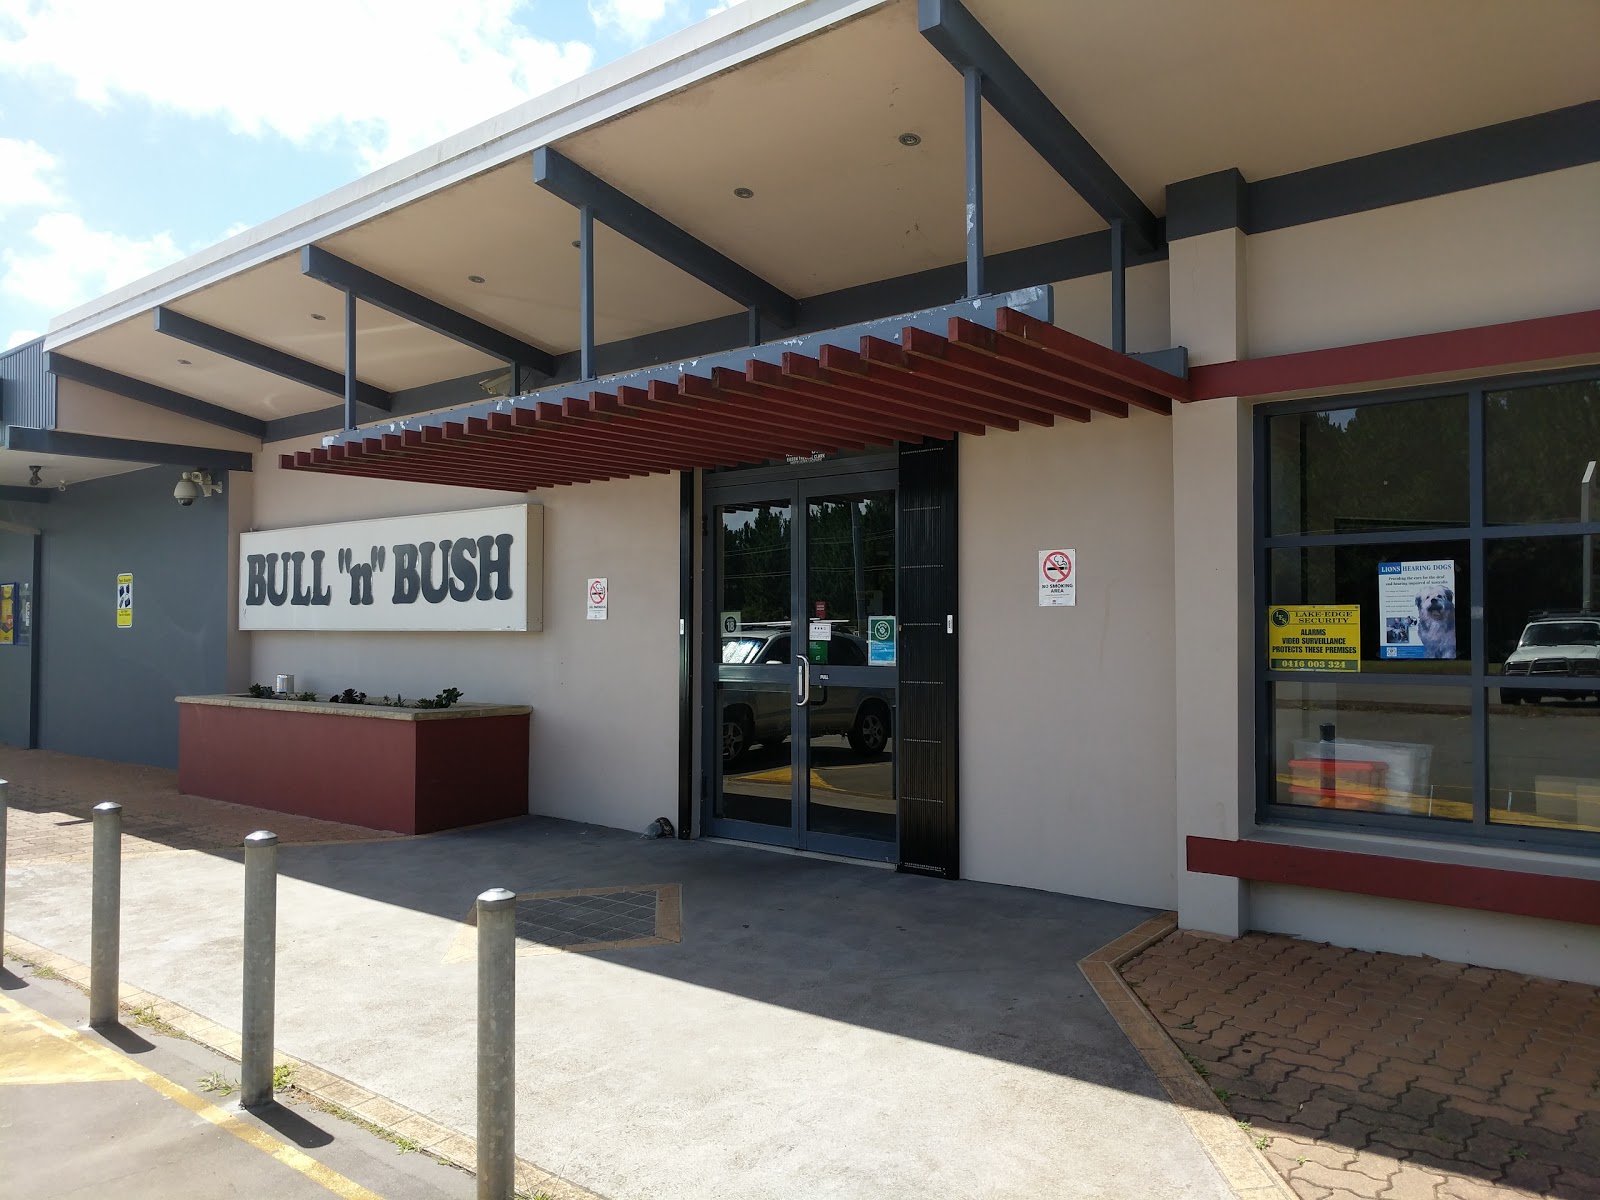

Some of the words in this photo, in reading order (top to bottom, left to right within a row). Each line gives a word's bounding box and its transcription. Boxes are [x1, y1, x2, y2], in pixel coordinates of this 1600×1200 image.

[246, 549, 331, 607] BULL
[338, 545, 386, 606] "n"
[392, 533, 514, 605] BUSH
[1381, 565, 1401, 573] LIONS
[1433, 563, 1452, 571] DOGS
[1300, 628, 1326, 636] ALARMS
[1281, 637, 1300, 645] VIDEO
[1301, 637, 1346, 645] SURVEILLANCE
[1325, 646, 1357, 654] PREMISES
[1281, 660, 1305, 668] 0416
[1307, 660, 1326, 668] 003
[1327, 661, 1346, 669] 324
